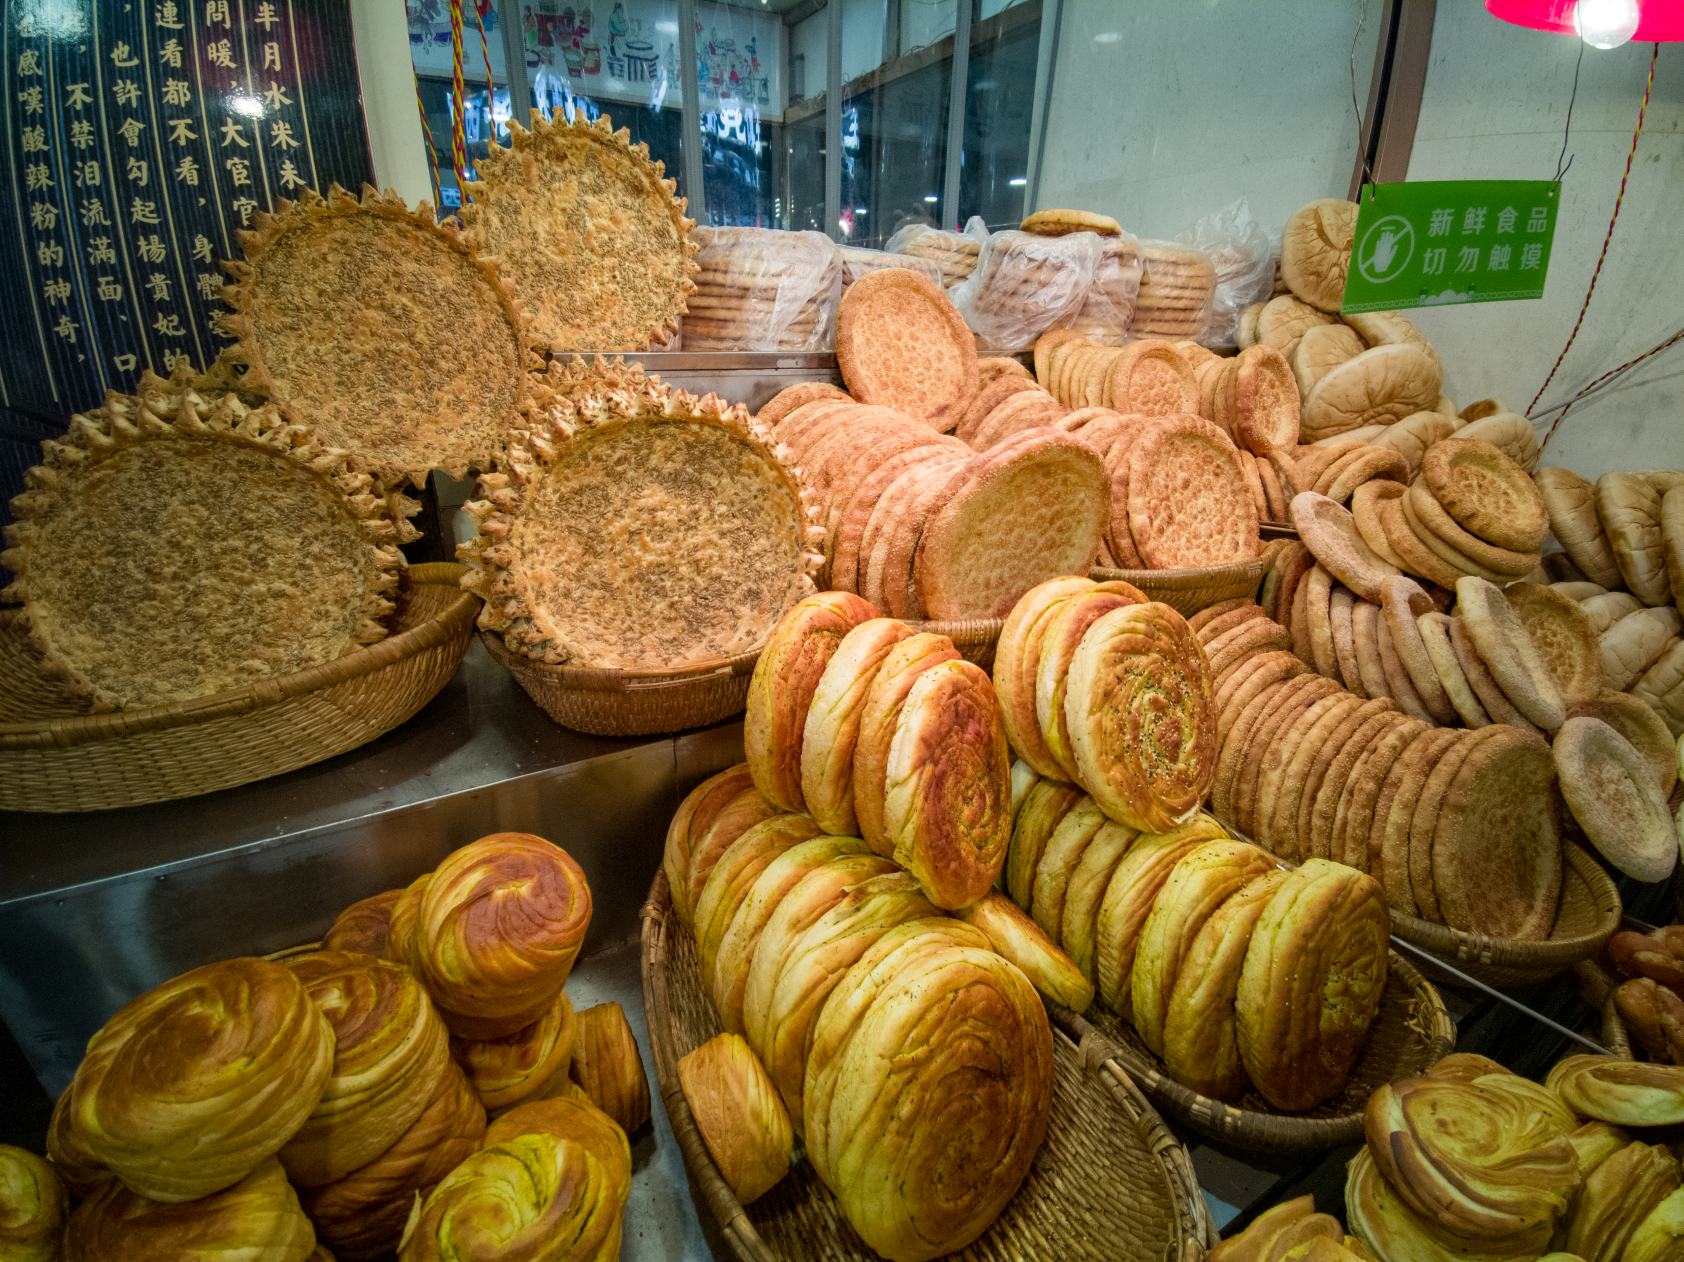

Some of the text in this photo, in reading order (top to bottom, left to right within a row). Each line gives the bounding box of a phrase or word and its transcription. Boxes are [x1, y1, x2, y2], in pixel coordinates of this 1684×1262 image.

[254, 2, 306, 209] 半月水米未
[1428, 206, 1548, 237] 新鲜食品
[1422, 243, 1543, 275] 切勿触摸
